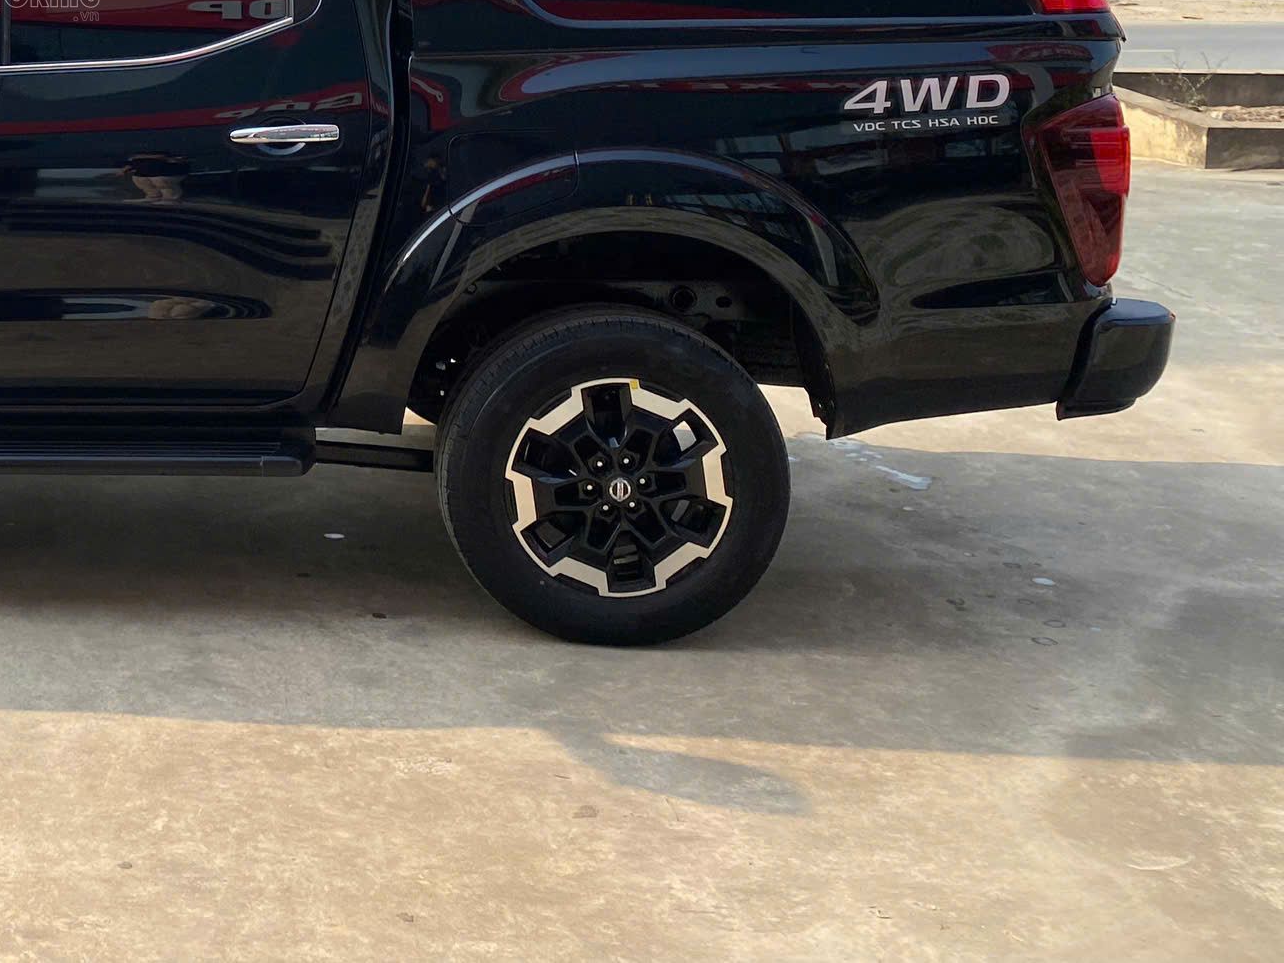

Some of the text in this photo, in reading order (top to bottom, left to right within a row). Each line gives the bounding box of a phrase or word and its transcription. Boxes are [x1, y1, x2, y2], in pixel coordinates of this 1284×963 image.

[843, 73, 1010, 114] 4WD
[853, 115, 999, 132] VDC TCS HSA HDC
